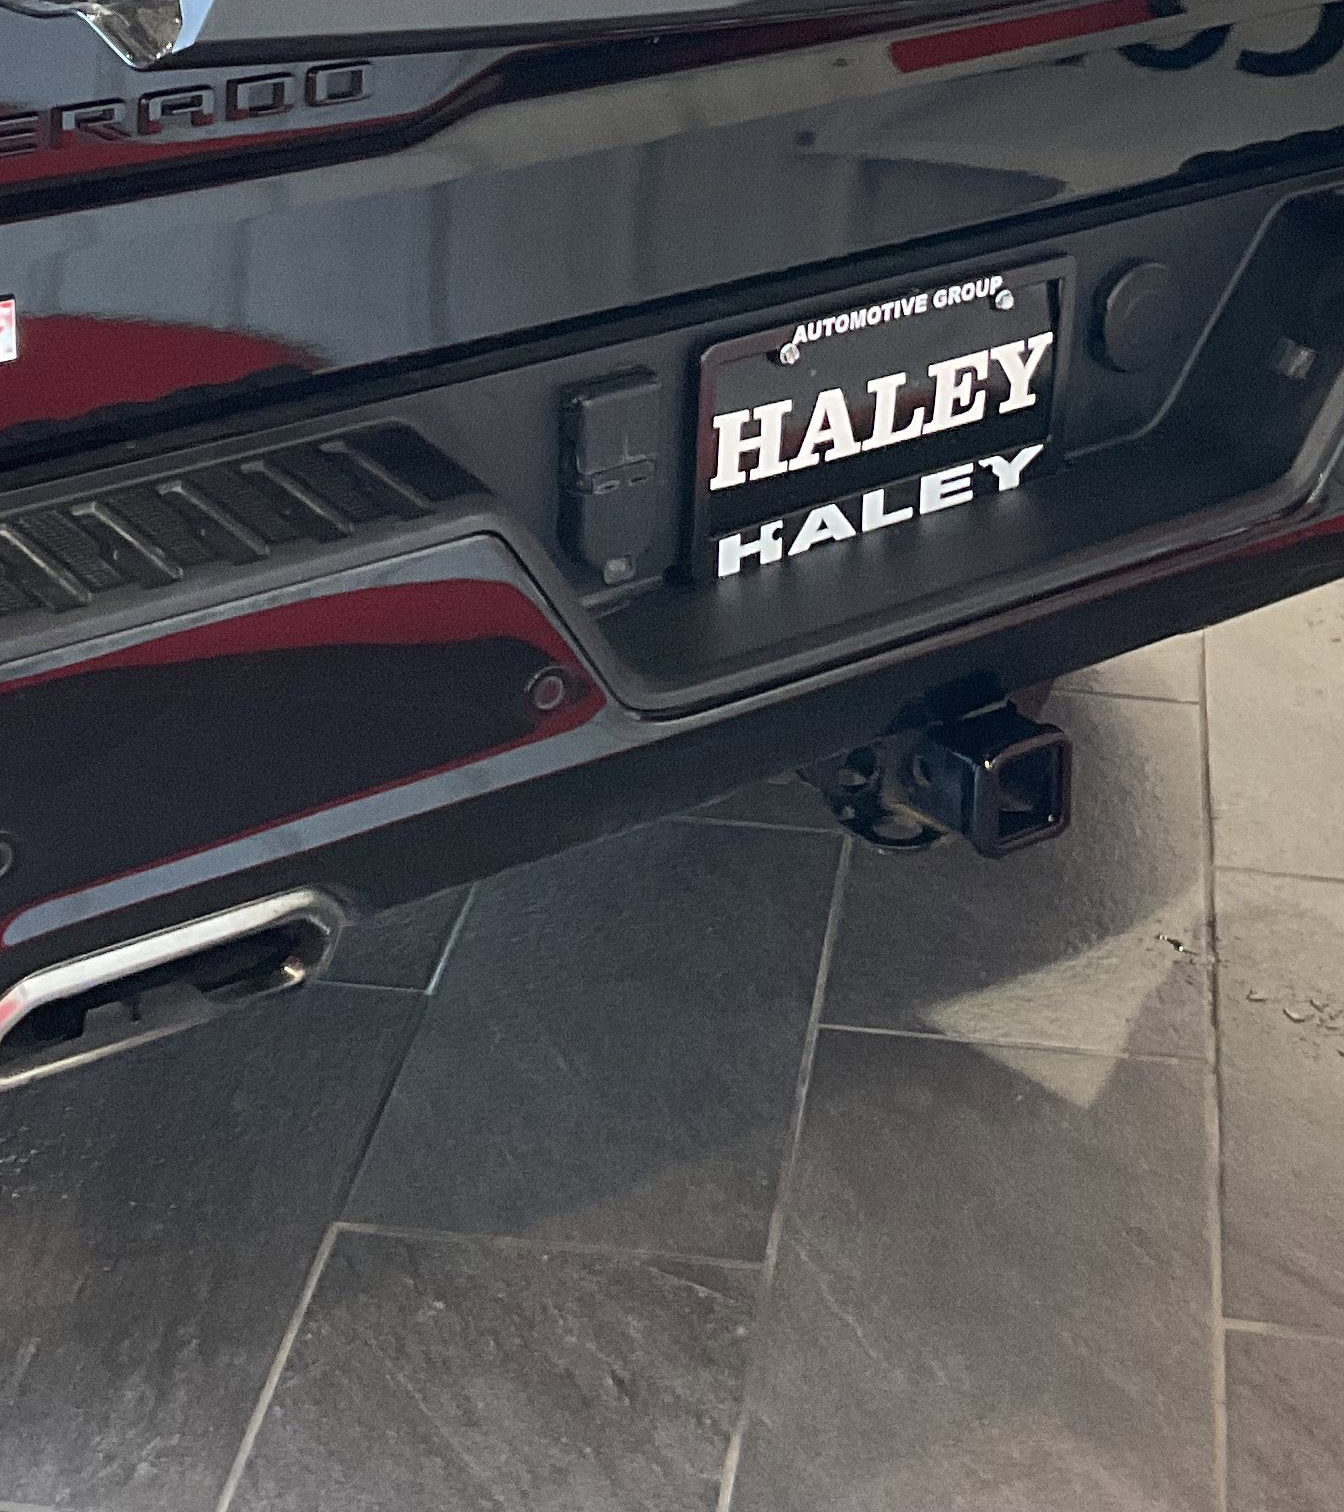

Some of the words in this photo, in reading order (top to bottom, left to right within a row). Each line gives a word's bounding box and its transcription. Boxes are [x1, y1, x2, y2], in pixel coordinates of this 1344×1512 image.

[792, 293, 929, 345] AUTOMOTIVE
[932, 275, 1004, 309] GROUP
[709, 332, 1054, 491] HALEY
[717, 444, 1045, 578] HALEY
